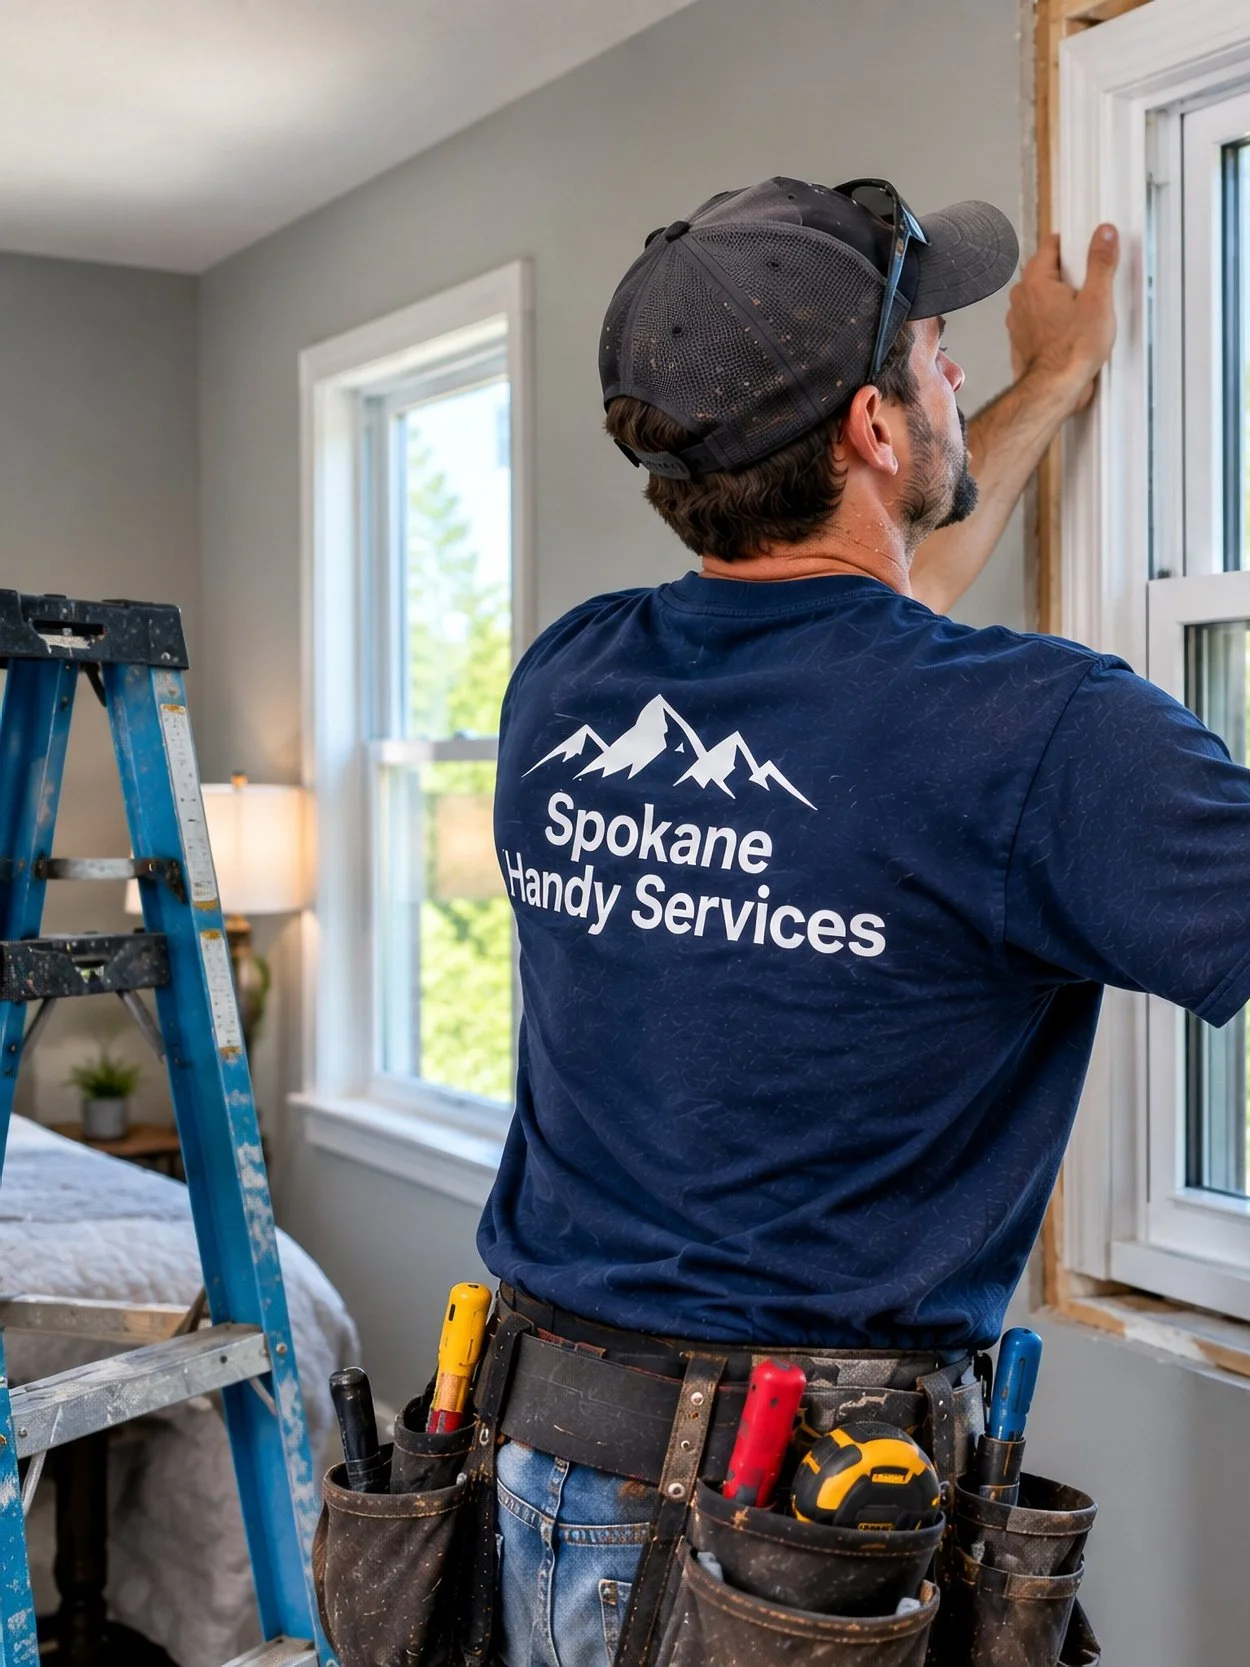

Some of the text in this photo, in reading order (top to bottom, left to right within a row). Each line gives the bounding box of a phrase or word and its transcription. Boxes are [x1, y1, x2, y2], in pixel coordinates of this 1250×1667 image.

[545, 792, 773, 874] Spokane
[504, 850, 886, 957] Handy Services
